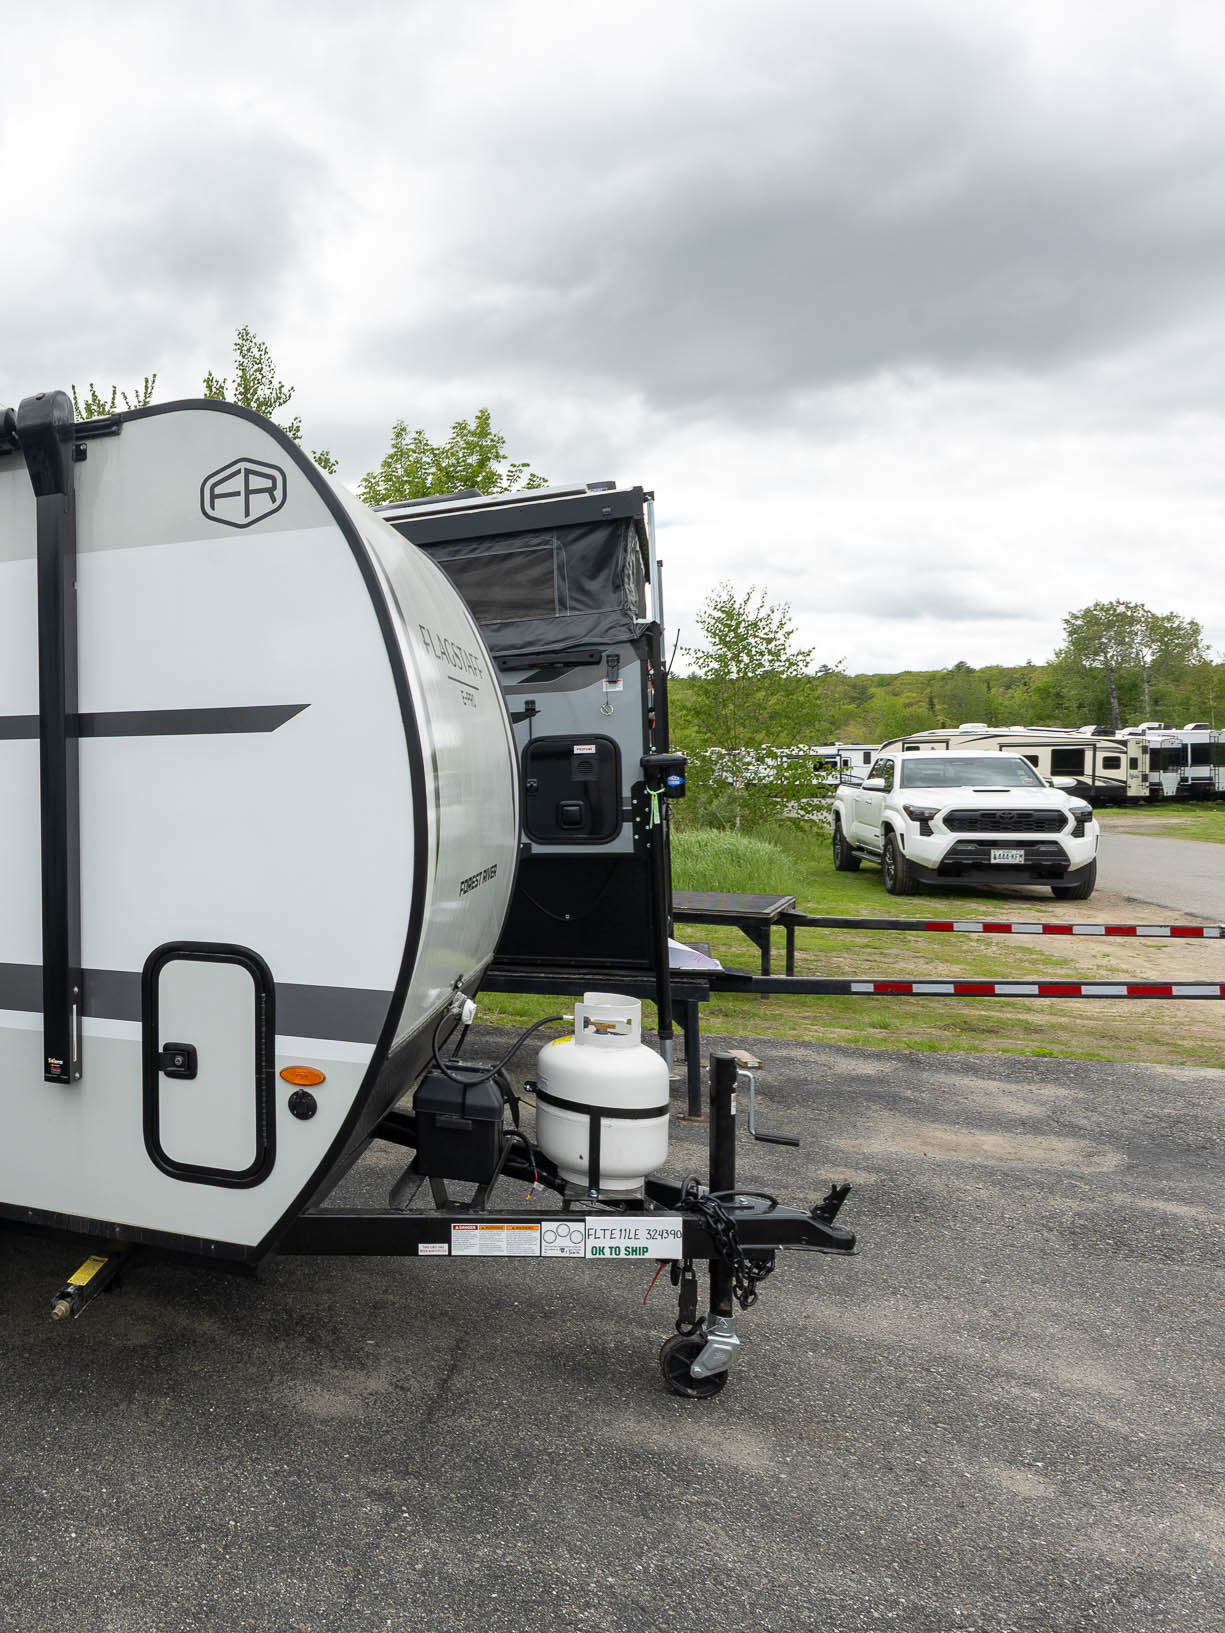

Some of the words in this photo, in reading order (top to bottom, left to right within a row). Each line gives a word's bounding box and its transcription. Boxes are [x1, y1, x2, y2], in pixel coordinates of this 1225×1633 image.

[419, 624, 483, 680] FLAGSTAFF
[459, 871, 483, 897] FOREST
[482, 864, 497, 884] RIVER
[645, 1228, 682, 1240] 324390
[591, 1245, 607, 1256] OK
[608, 1246, 621, 1256] TO
[624, 1246, 649, 1256] SHIP
